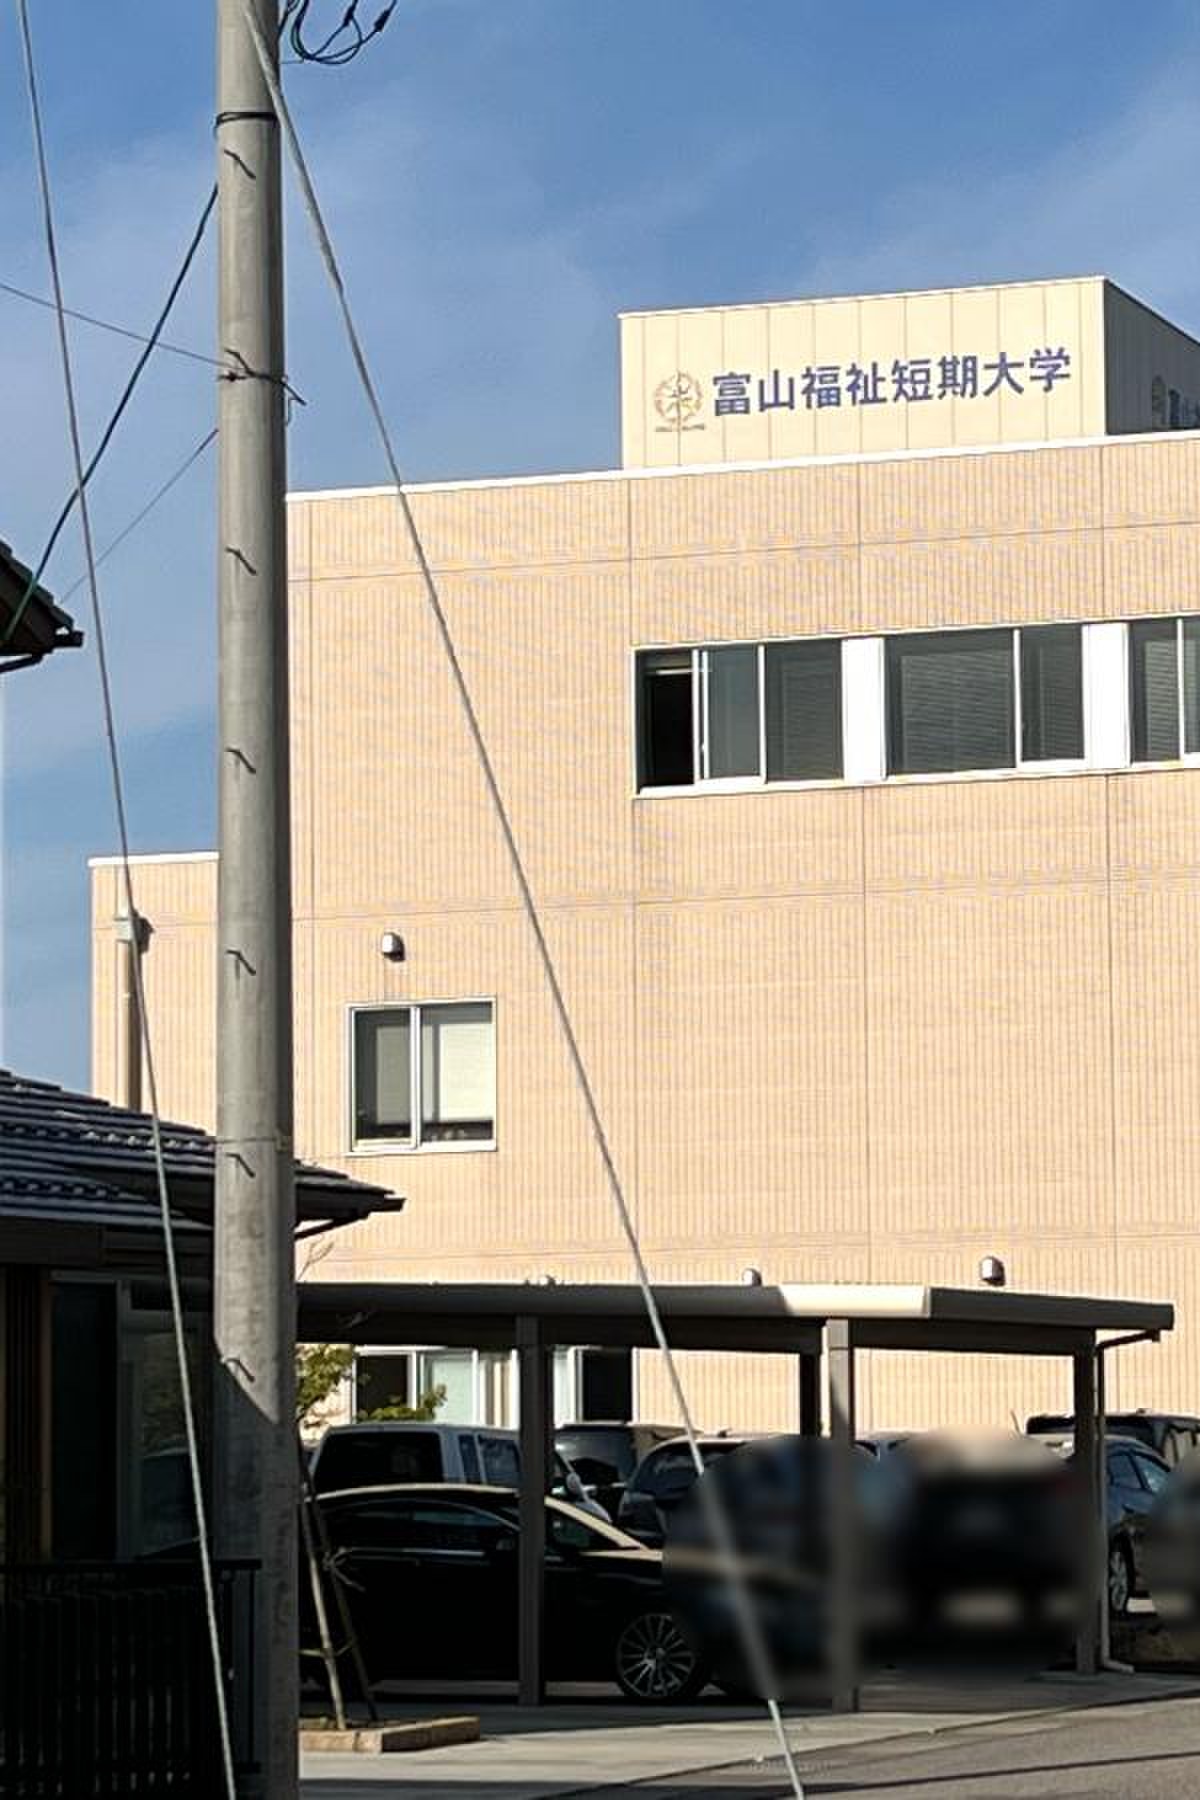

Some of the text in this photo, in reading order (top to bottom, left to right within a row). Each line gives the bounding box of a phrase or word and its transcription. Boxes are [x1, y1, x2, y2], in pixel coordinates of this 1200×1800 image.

[712, 347, 1071, 416] 富山福祉短期大学
